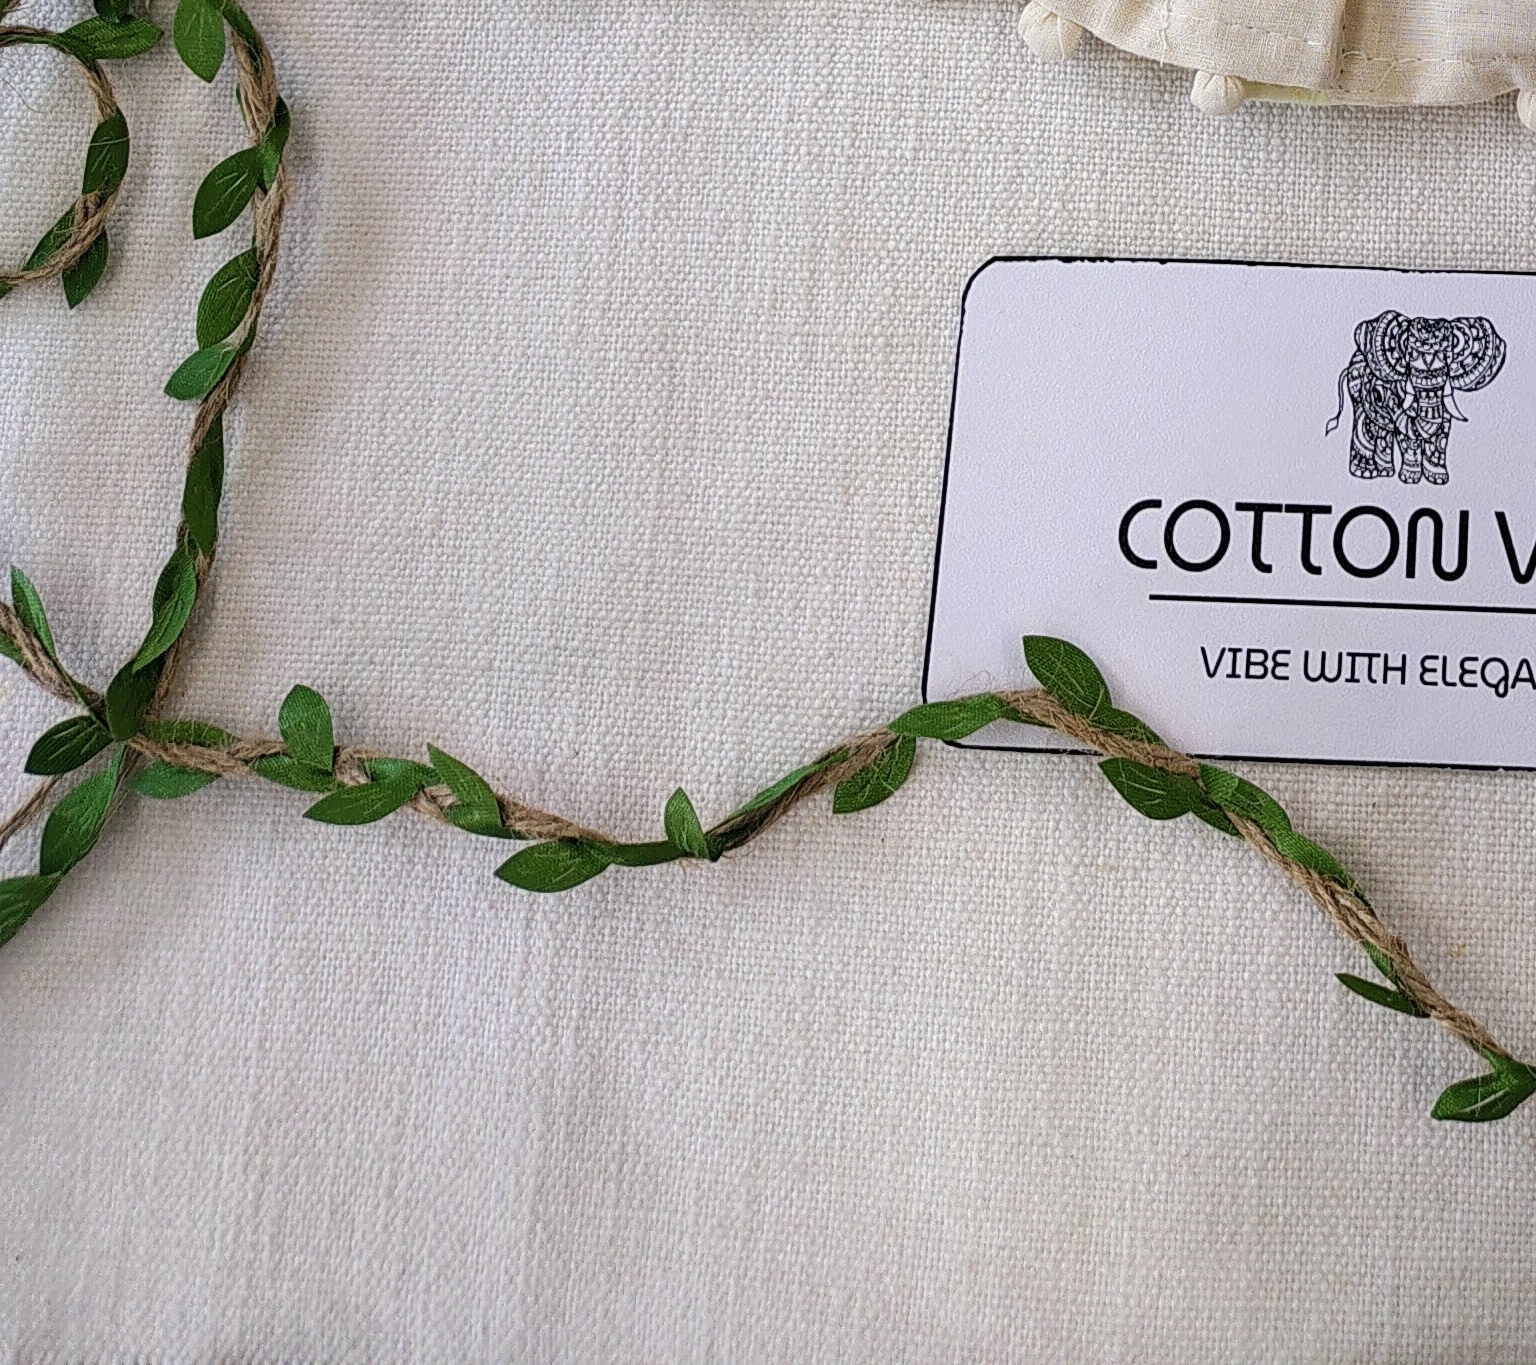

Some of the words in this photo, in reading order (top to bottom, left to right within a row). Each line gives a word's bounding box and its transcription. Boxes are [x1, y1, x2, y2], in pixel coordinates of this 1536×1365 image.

[1118, 499, 1471, 583] COTTON
[1200, 645, 1291, 681] VIBE
[1302, 649, 1408, 686] WITH
